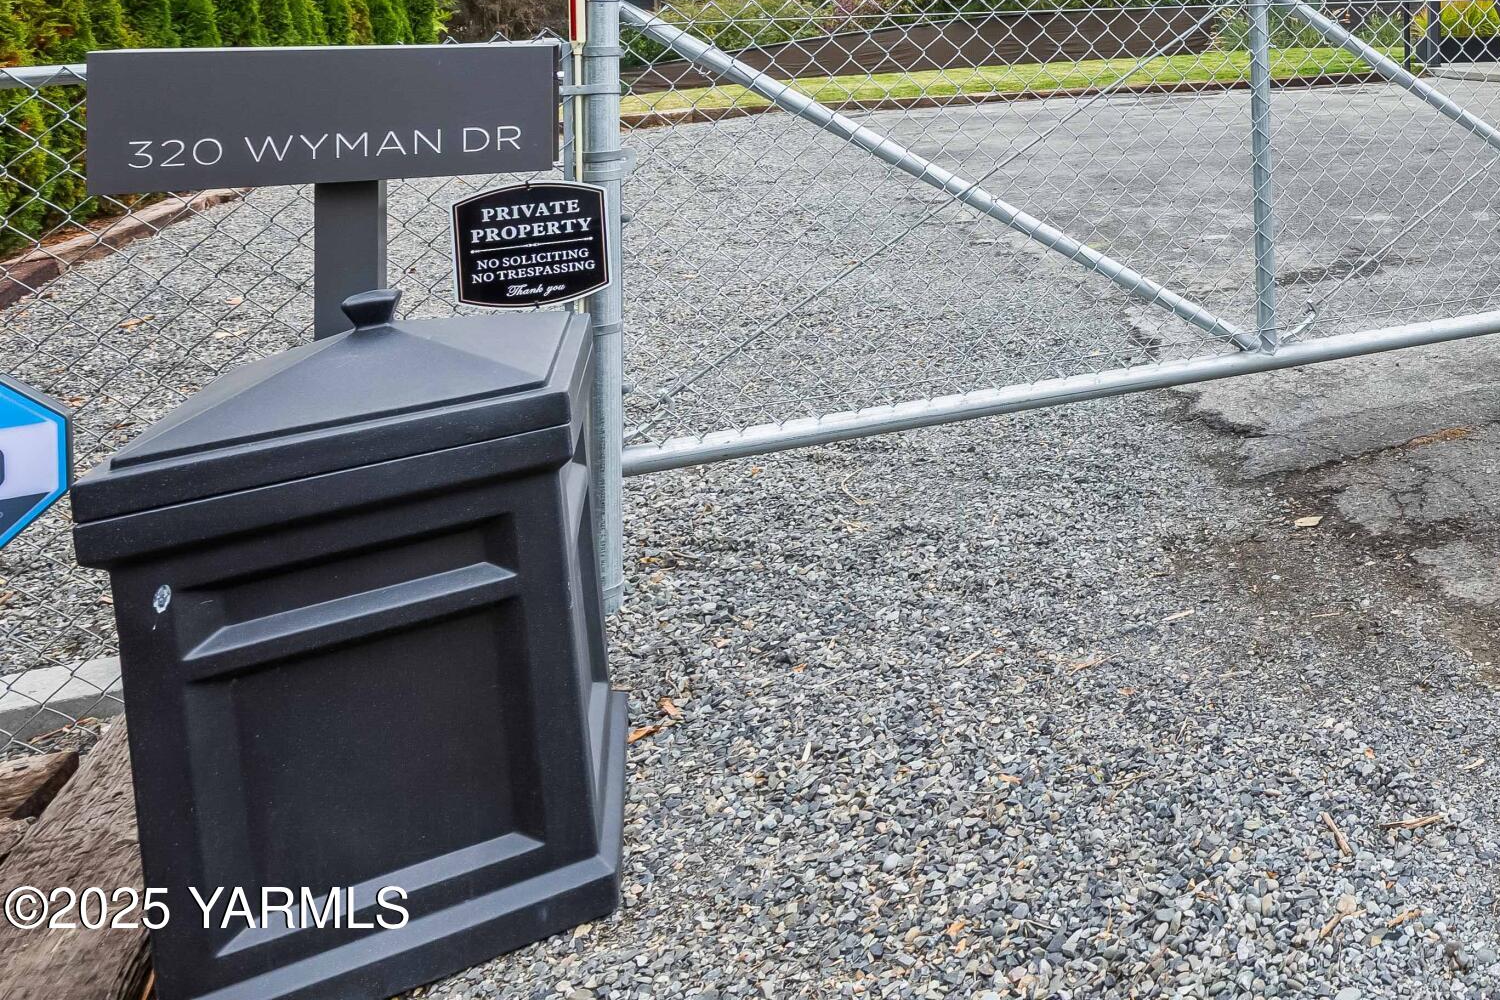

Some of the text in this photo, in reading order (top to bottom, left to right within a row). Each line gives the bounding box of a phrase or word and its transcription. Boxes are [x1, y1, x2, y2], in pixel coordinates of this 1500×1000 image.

[128, 125, 523, 169] 320 WYMAN DR
[481, 199, 580, 223] PRIVATE
[470, 217, 593, 244] PROPERTY
[476, 247, 590, 270] NO SOLICITING
[471, 259, 596, 284] NO TRESPASSING
[505, 283, 566, 297] Thank you
